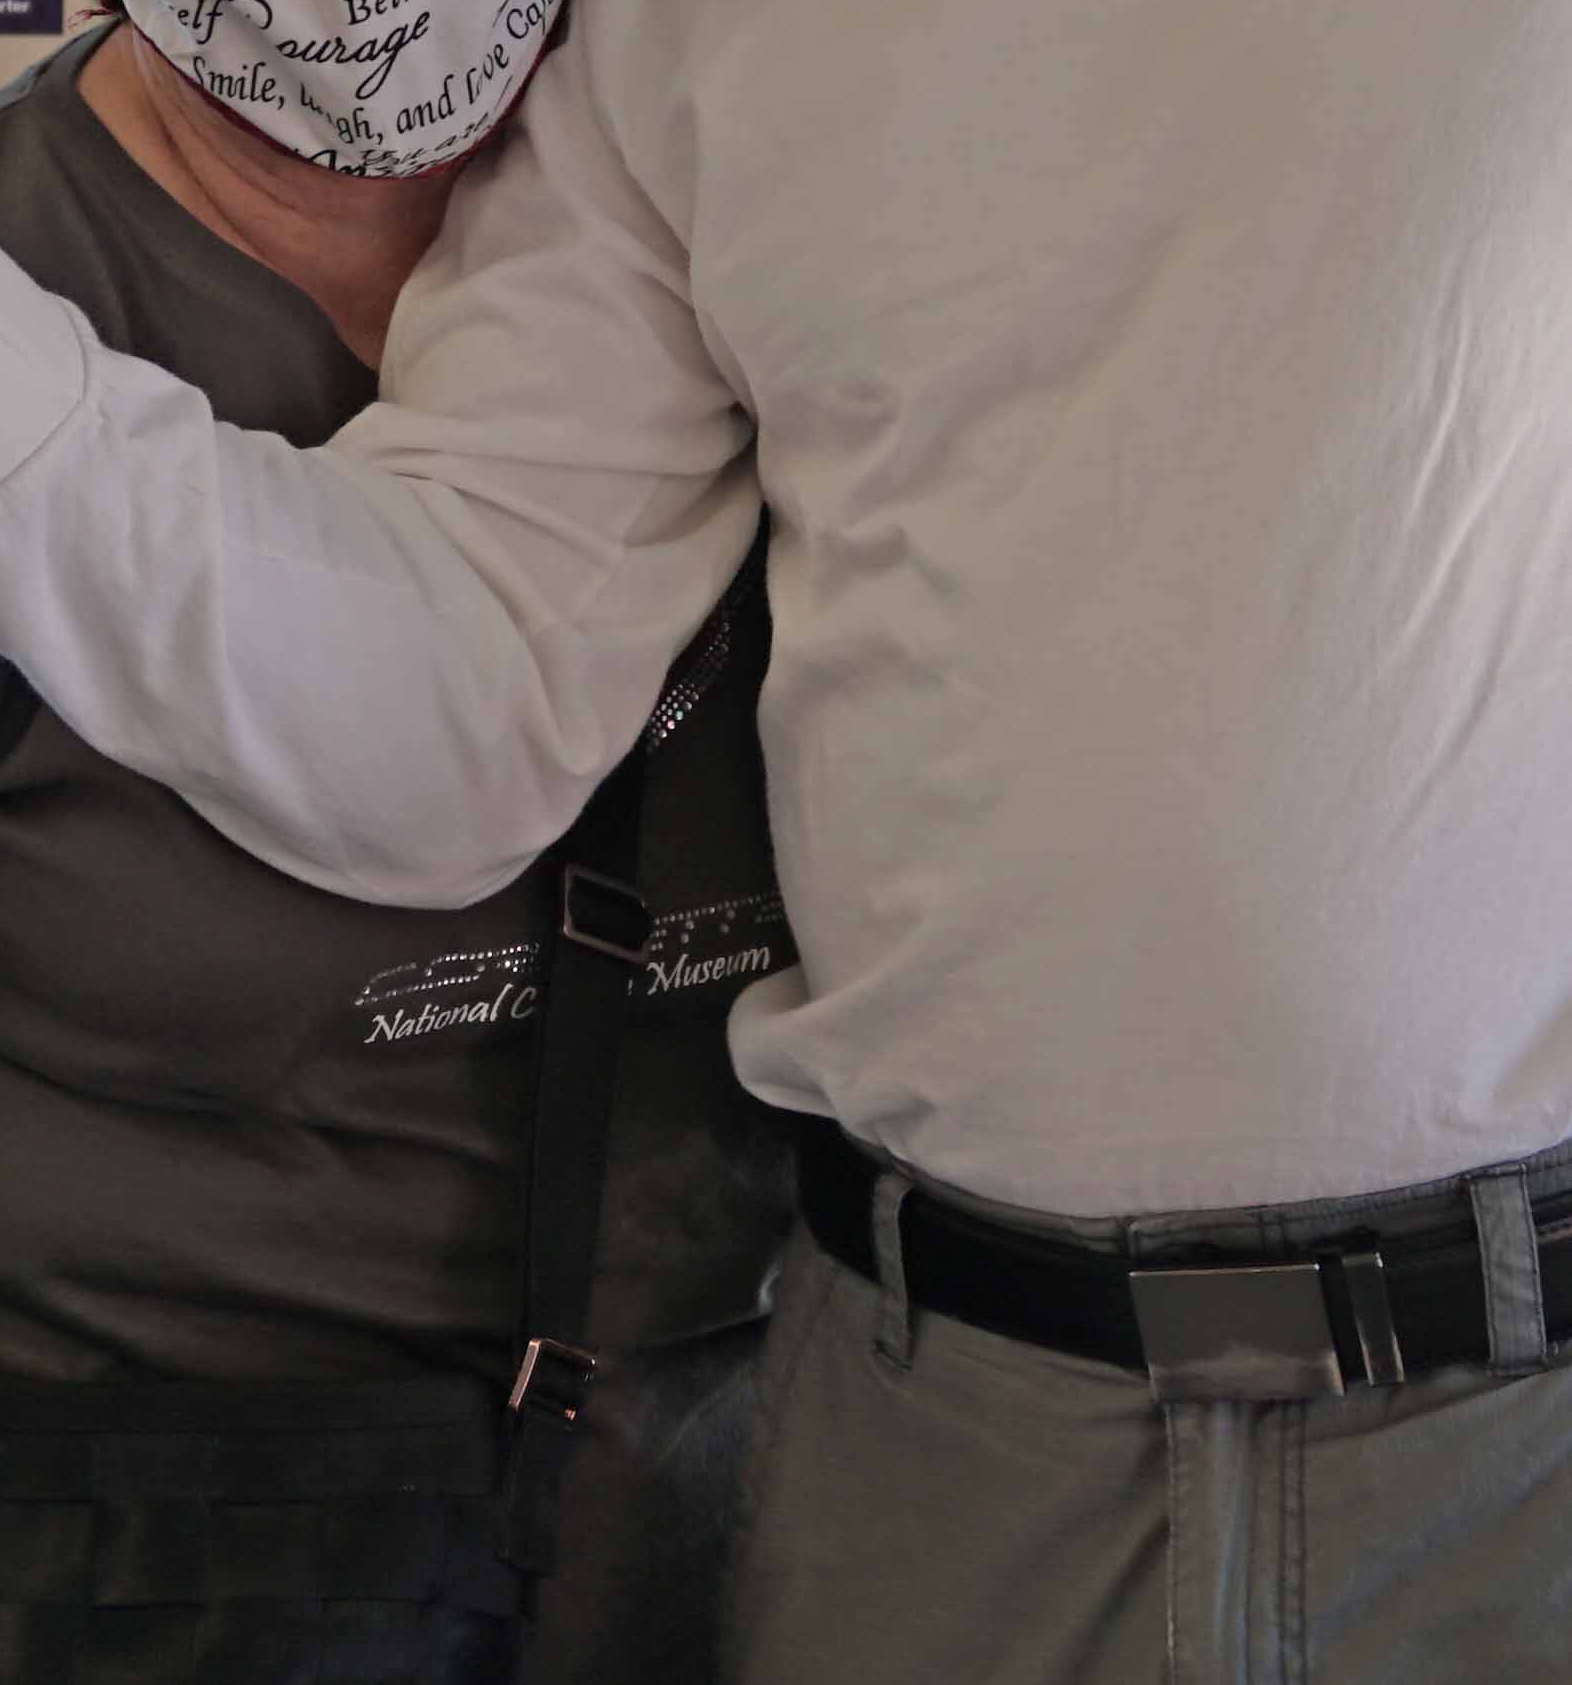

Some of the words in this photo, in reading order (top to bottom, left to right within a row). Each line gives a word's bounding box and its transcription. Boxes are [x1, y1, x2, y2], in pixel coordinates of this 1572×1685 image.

[193, 55, 285, 110] Smile,
[395, 74, 457, 135] and
[466, 42, 511, 106] love
[647, 945, 772, 996] Museum
[363, 983, 512, 1045] National
